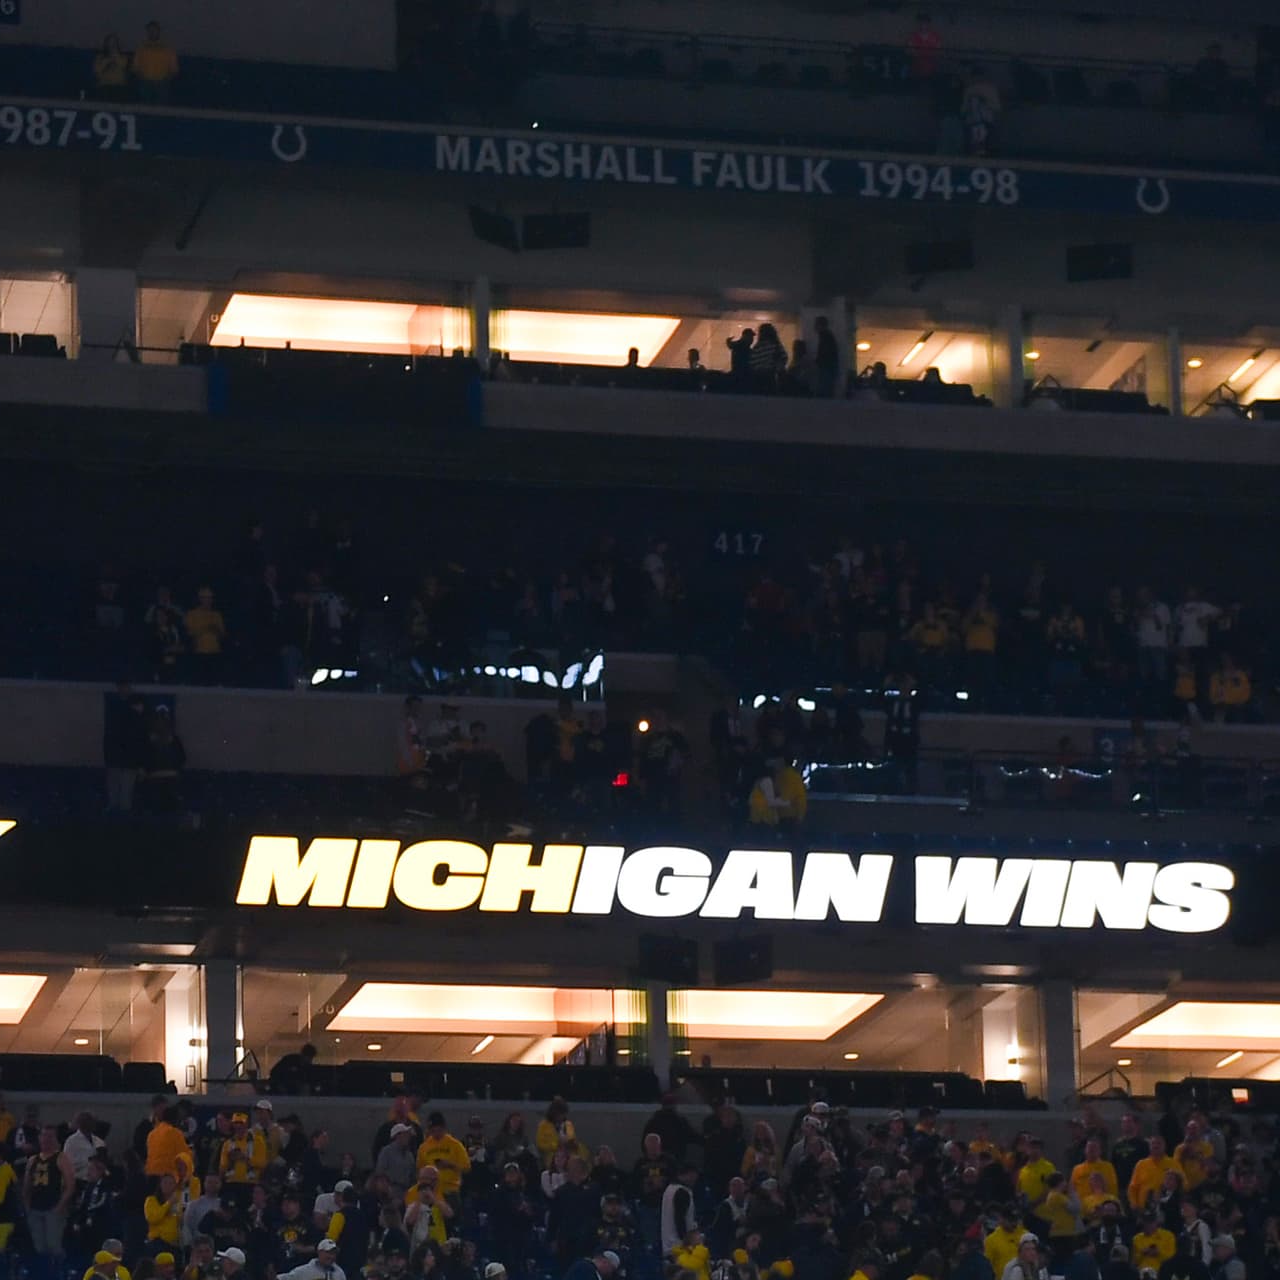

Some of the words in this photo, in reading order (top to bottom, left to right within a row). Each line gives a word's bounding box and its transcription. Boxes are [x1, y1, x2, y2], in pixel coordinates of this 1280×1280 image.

[434, 133, 677, 186] MARSHALL
[691, 151, 833, 196] FAULK
[858, 161, 1020, 205] 1994-98
[713, 531, 764, 557] 417
[235, 835, 892, 922] MICHIGAN
[915, 855, 1236, 935] WINS
